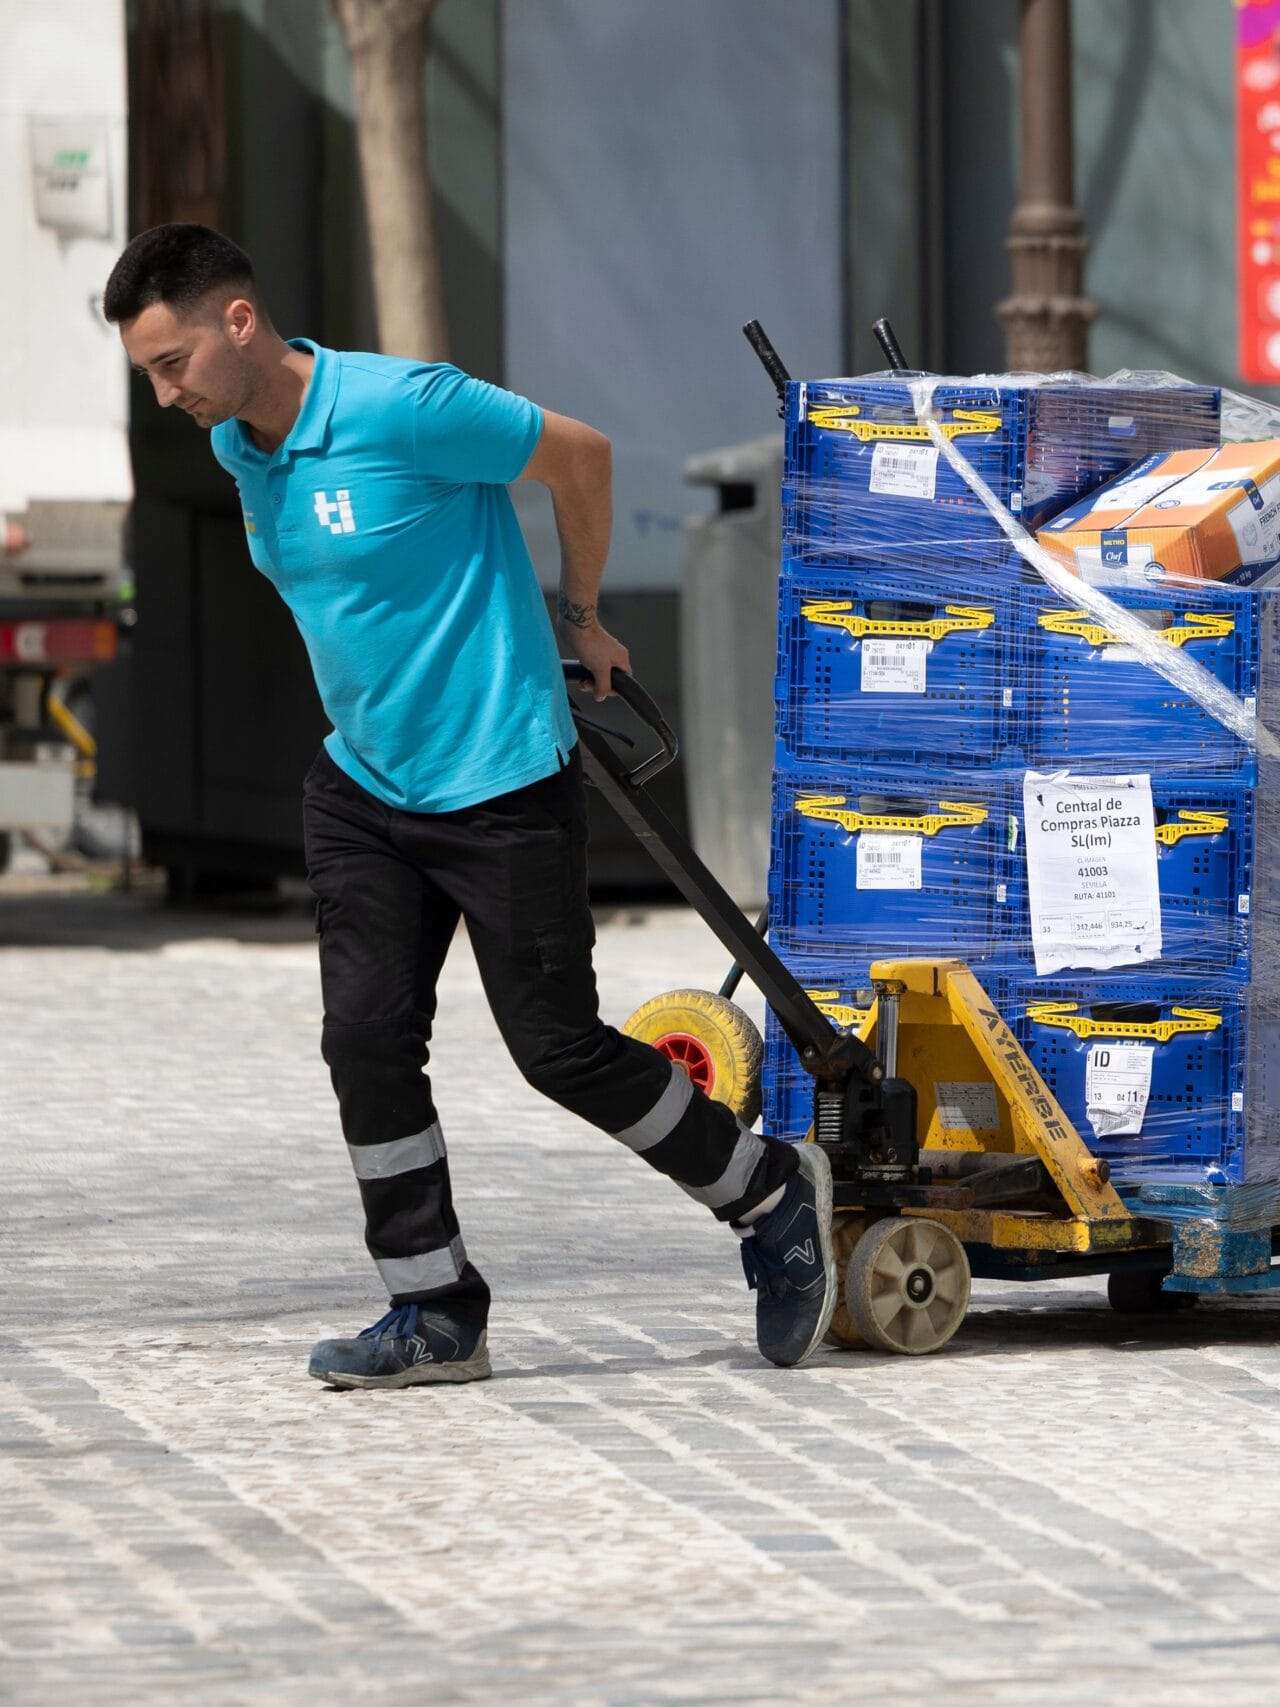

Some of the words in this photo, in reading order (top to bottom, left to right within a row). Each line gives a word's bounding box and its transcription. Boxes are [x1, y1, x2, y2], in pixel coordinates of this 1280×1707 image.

[1258, 506, 1278, 527] FRENCH
[1105, 551, 1124, 562] Chef
[1055, 797, 1102, 815] Central
[1105, 797, 1123, 811] de
[1041, 817, 1098, 834] Compras
[1101, 815, 1141, 829] Piazza
[1077, 866, 1109, 878] 41003
[1081, 880, 1108, 890] SEVILLA
[1074, 892, 1094, 901] RUTA:
[1095, 890, 1116, 900] 41101
[1094, 1050, 1111, 1068] ID
[977, 1007, 1068, 1142] AYERBE
[1093, 1092, 1103, 1102] 13
